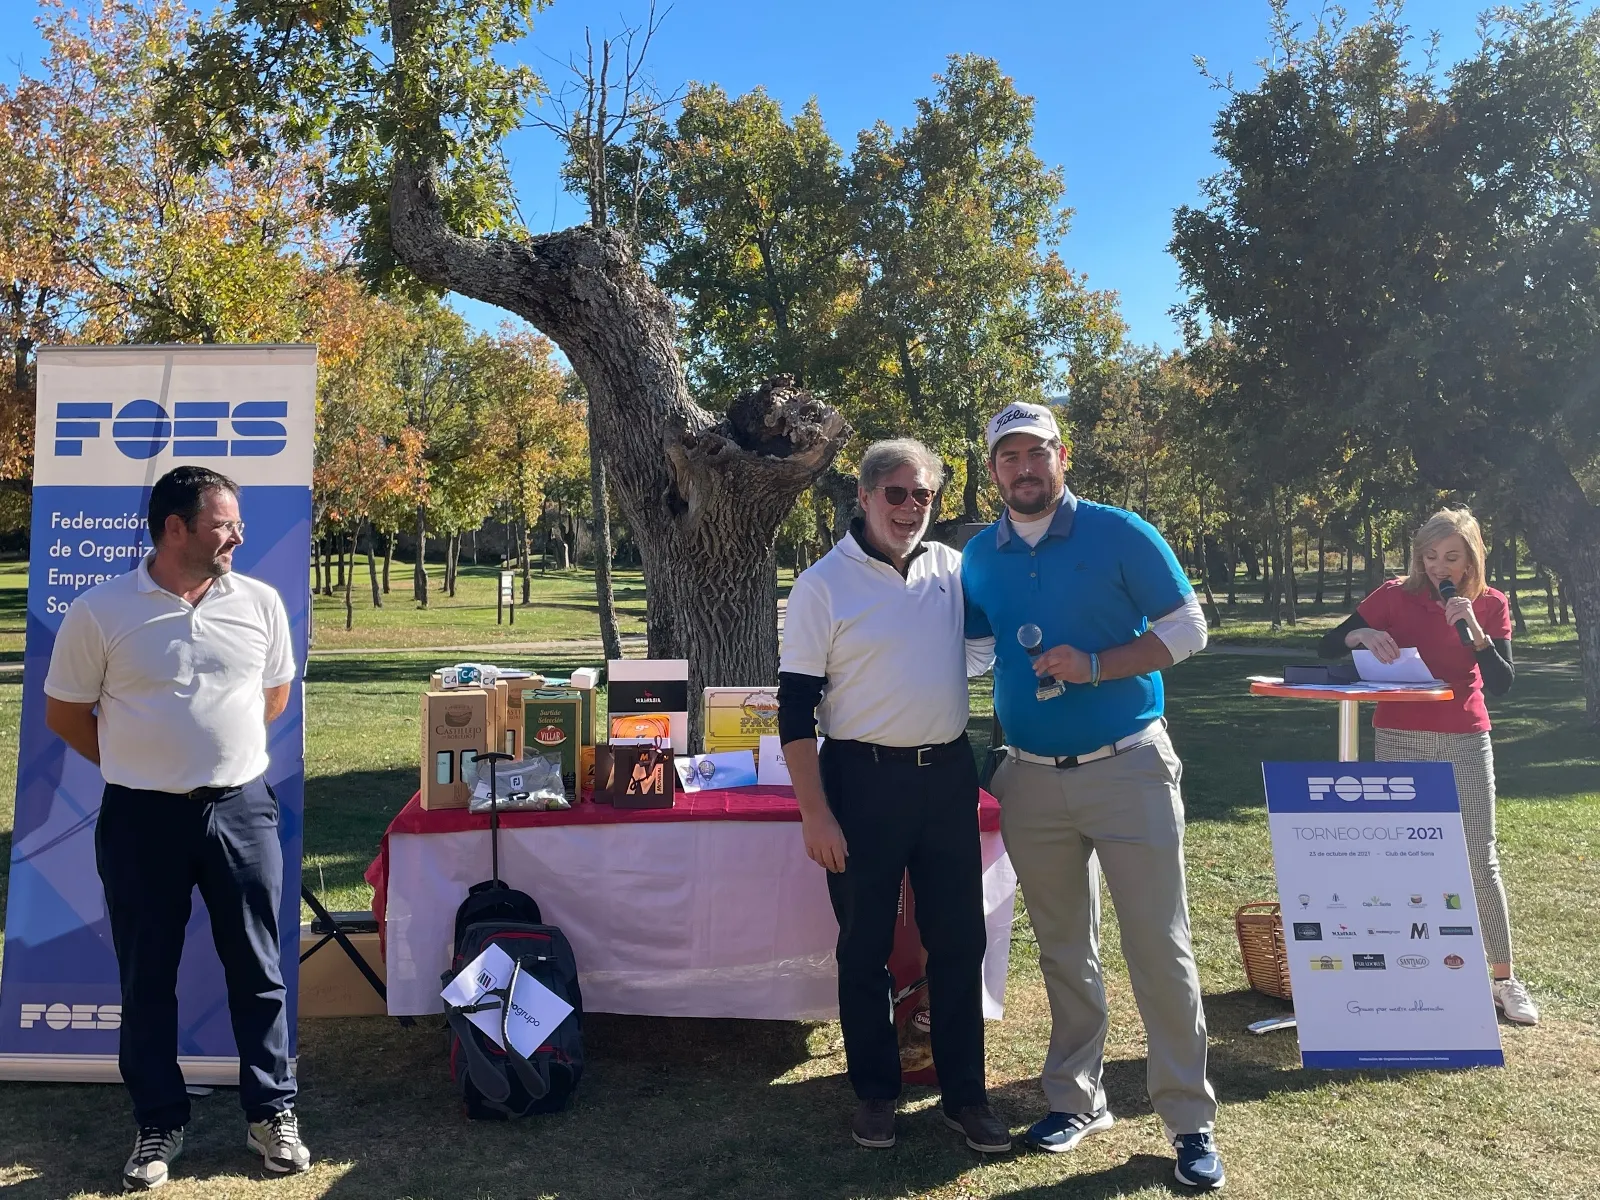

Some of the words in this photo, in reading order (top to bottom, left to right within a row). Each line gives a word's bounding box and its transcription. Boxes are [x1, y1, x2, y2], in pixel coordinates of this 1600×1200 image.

[995, 409, 1040, 432] Titleist
[54, 399, 288, 460] FOES
[51, 511, 149, 529] Federación
[49, 540, 72, 557] de
[46, 596, 74, 613] So
[443, 676, 457, 684] C4
[482, 677, 496, 685] C4
[435, 725, 481, 739] CASTILLEJO
[540, 731, 561, 741] VILLAR
[1307, 776, 1417, 801] FOES
[1292, 826, 1360, 840] TORNEO
[1363, 826, 1404, 840] GOLF
[1406, 827, 1444, 840] 2021
[1399, 958, 1427, 966] SANTIAGO
[20, 1003, 122, 1030] FOES
[511, 1001, 540, 1027] ogrupo
